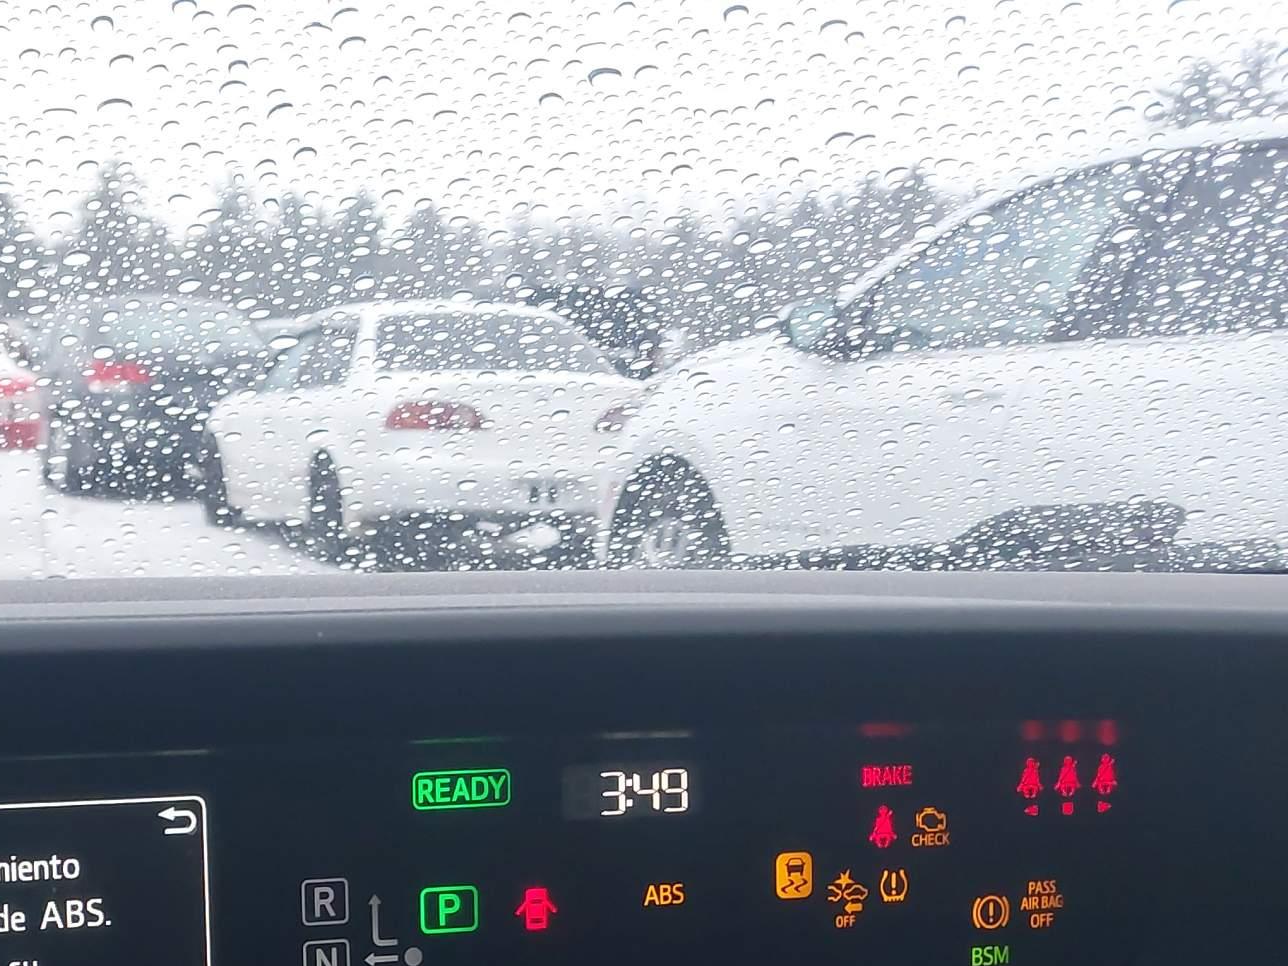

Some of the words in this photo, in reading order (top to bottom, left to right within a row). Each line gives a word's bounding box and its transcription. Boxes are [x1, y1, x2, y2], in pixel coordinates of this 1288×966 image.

[861, 765, 913, 787] BRAKE
[416, 774, 506, 803] READY
[601, 769, 688, 815] 3:49
[912, 833, 950, 847] CHECK
[643, 883, 685, 906] ABS
[1028, 880, 1057, 894] PASS
[314, 886, 336, 918] R
[438, 893, 461, 926] P
[1020, 896, 1040, 911] AIR
[39, 898, 113, 930] ABS.
[835, 915, 856, 928] OFF
[1029, 912, 1055, 928] OFF
[971, 945, 1010, 966] BSM
